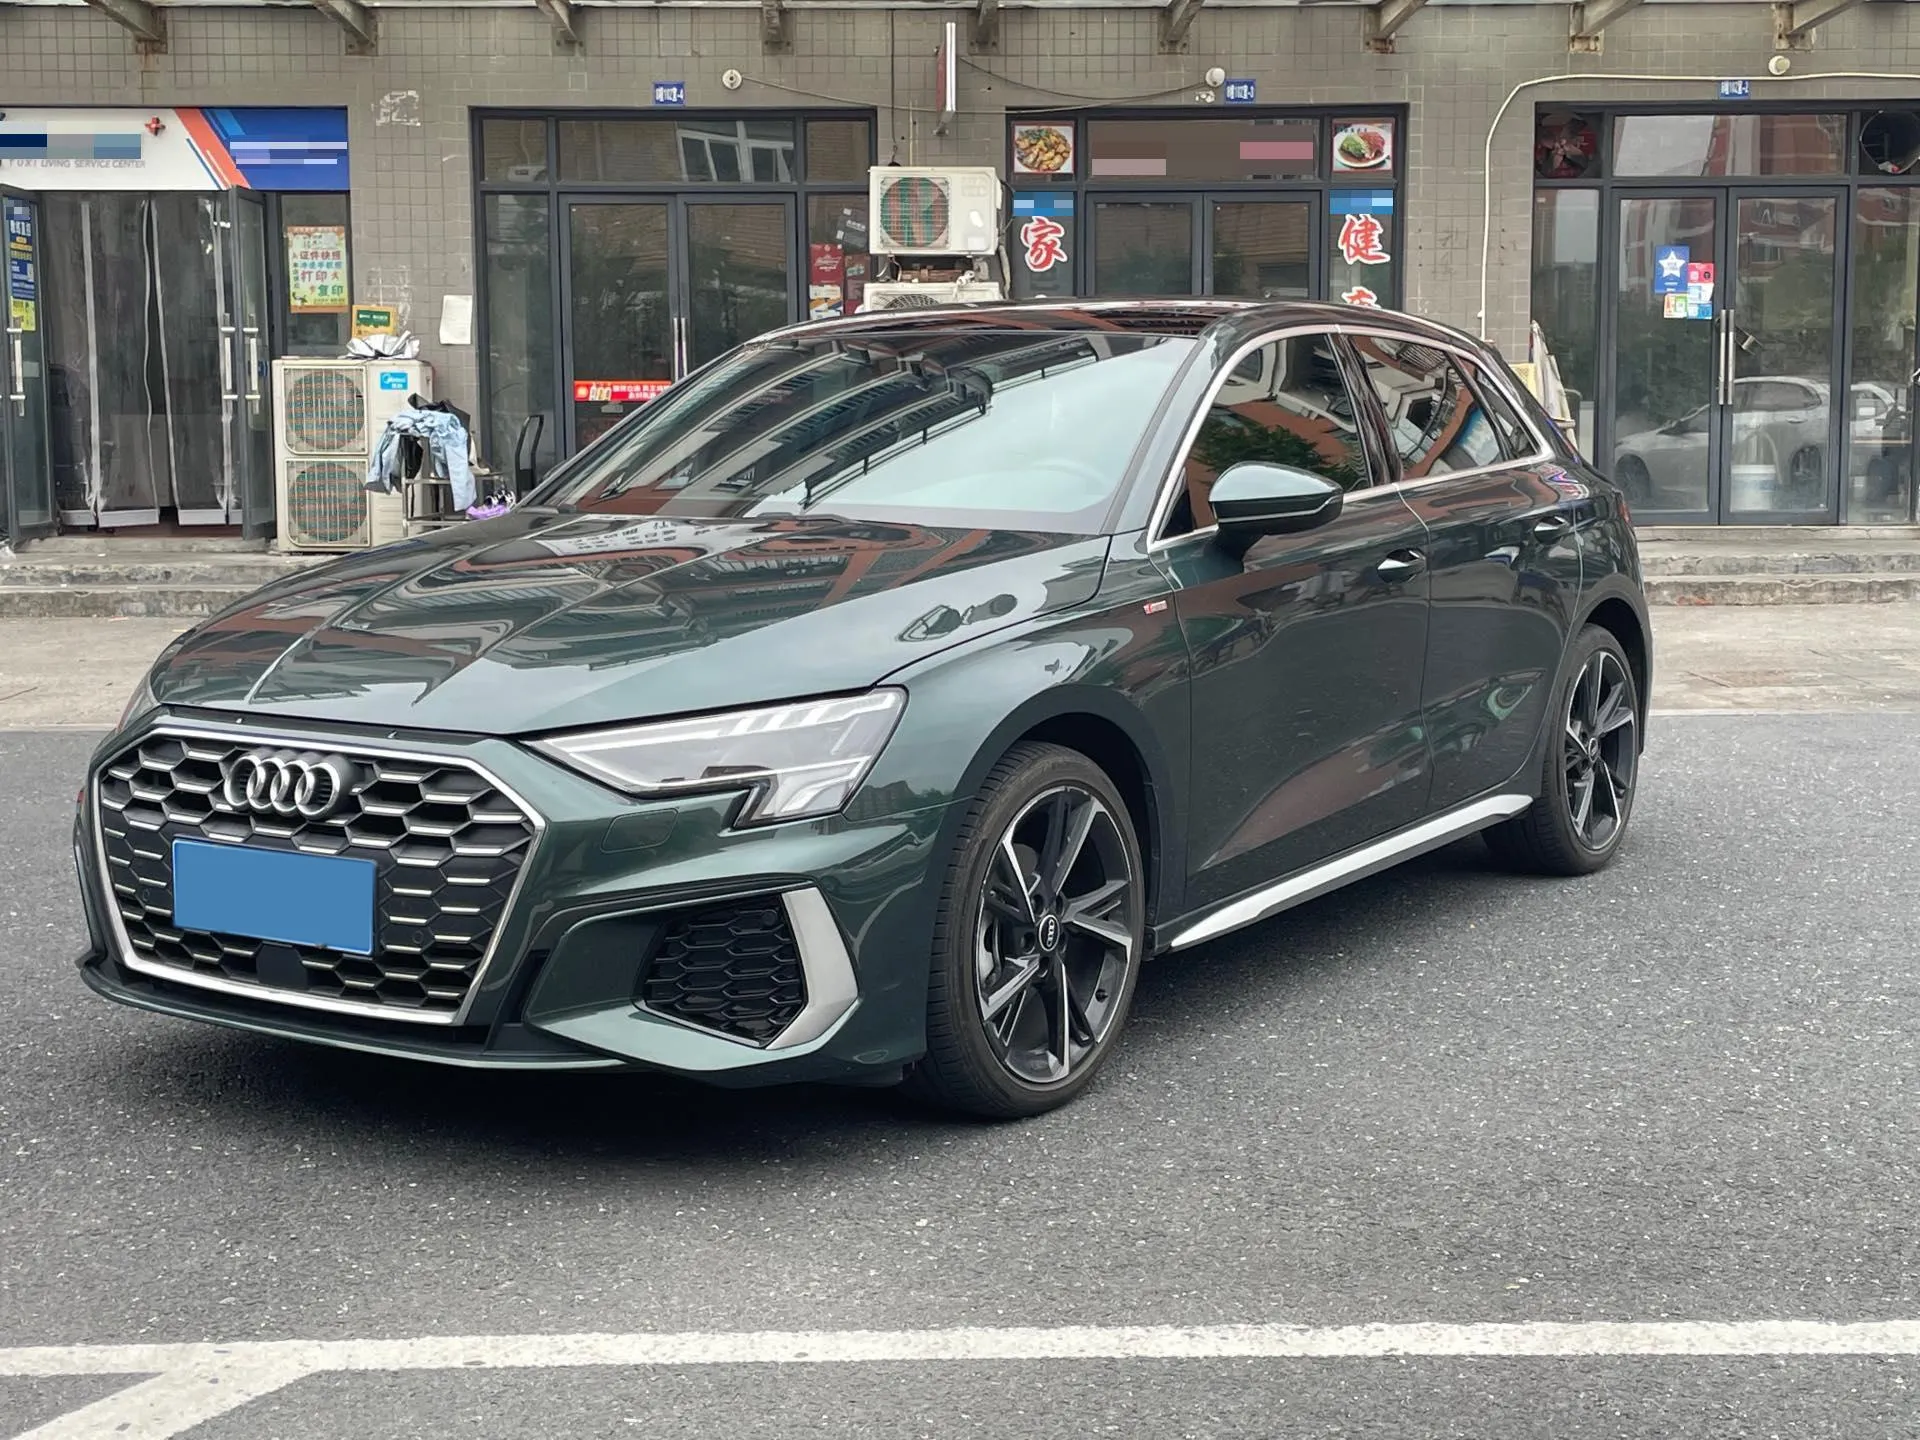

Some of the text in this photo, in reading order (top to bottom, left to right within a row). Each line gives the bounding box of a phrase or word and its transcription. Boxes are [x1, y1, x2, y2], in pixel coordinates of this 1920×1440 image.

[41, 159, 71, 168] LIVING
[74, 159, 111, 168] SERVICE
[112, 160, 146, 168] CENTER
[1020, 216, 1068, 272] 家
[301, 270, 328, 282] 打印
[317, 284, 344, 297] 复印
